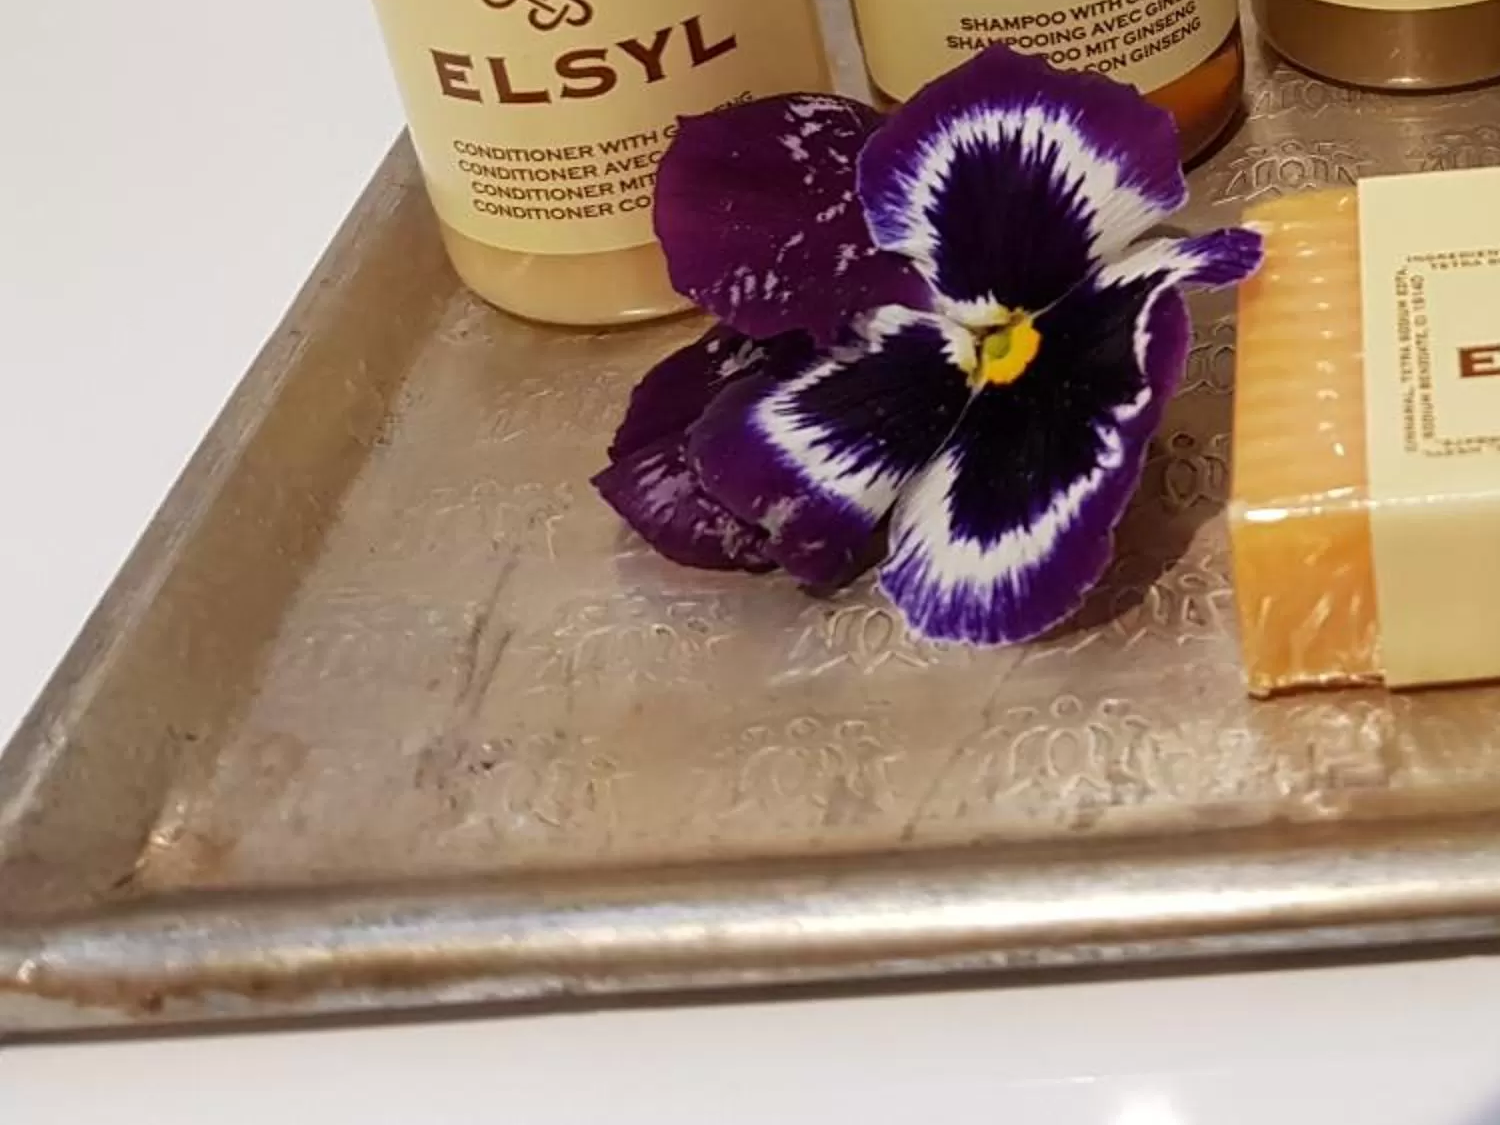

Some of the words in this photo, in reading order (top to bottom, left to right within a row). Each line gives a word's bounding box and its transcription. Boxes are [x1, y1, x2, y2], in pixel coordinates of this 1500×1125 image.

[960, 11, 1067, 32] SHAMPOO
[1085, 37, 1121, 62] MIT
[1123, 0, 1197, 47] GINSENG
[1091, 9, 1143, 37] AVEC
[1130, 16, 1203, 63] GINSENG
[430, 15, 737, 104] ELSYL
[453, 139, 594, 163] CONDITIONER
[600, 131, 658, 156] WITH
[458, 159, 598, 182] CONDITIONER
[604, 150, 662, 176] AVEC
[471, 180, 613, 202] CONDITIONER
[618, 173, 656, 195] MIT
[473, 198, 614, 221] CONDITIONER
[618, 196, 652, 215] CO
